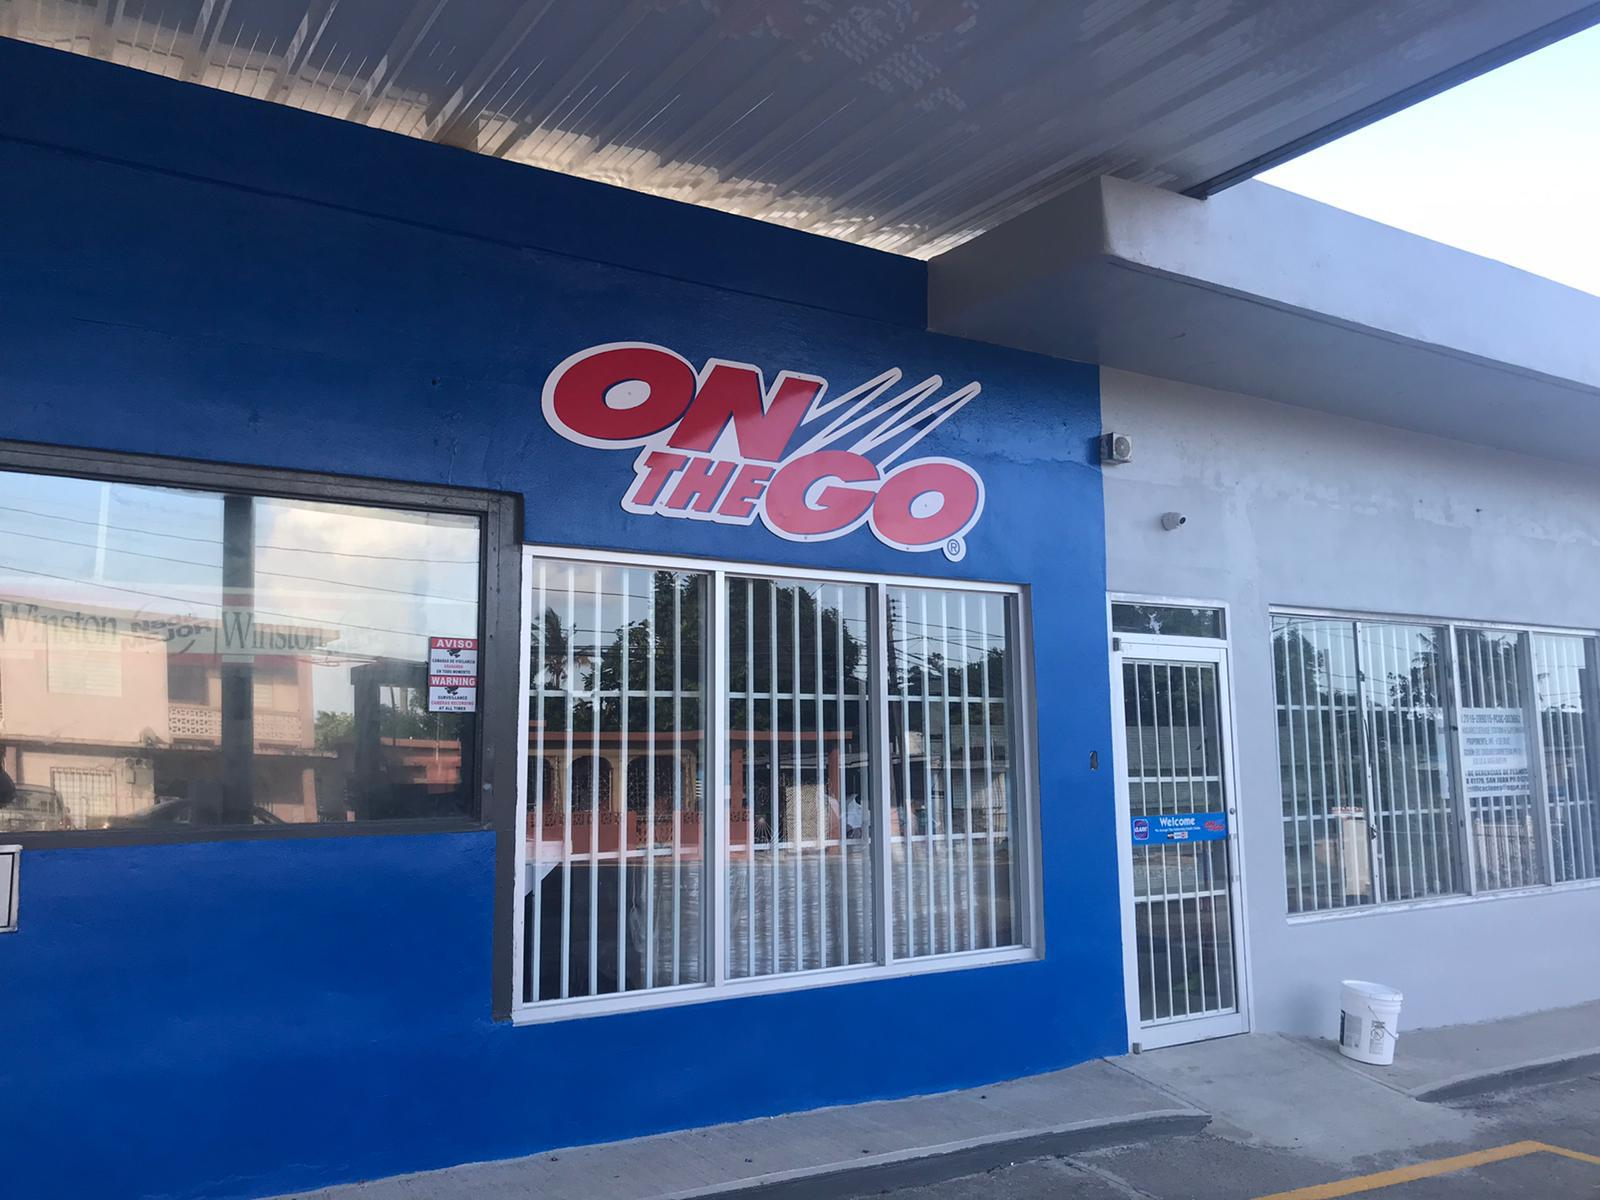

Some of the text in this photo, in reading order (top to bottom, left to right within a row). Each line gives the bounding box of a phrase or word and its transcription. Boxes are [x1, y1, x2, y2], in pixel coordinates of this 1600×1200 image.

[551, 346, 824, 462] ON
[631, 450, 778, 518] THE
[764, 450, 981, 546] GO
[0, 604, 117, 645] Winston
[222, 611, 324, 651] Winston
[436, 640, 472, 648] AVISO
[431, 677, 475, 686] WARNING
[1160, 816, 1196, 826] Welcome
